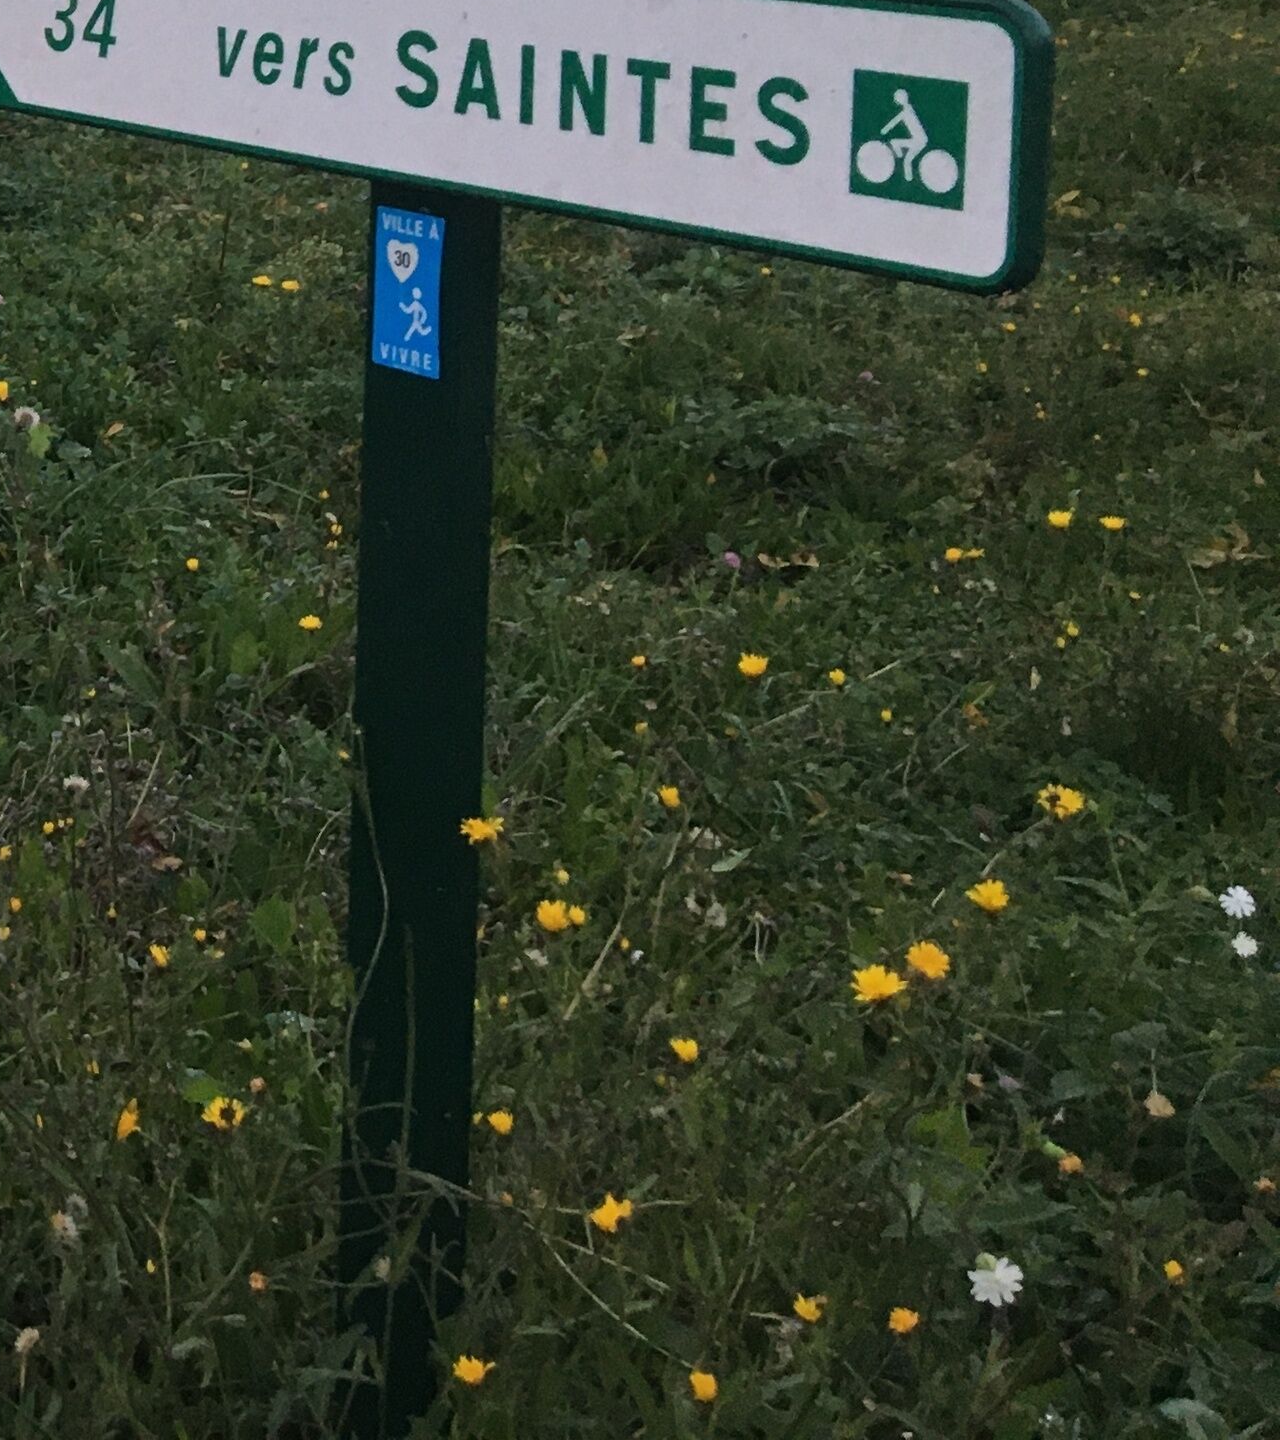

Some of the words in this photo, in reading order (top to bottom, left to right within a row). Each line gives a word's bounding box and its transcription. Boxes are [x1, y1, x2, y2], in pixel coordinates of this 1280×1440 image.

[215, 24, 357, 98] vers
[393, 27, 813, 167] SAINTES
[382, 212, 424, 238] VILLE
[393, 250, 411, 269] 30
[379, 342, 433, 371] VIVRE
